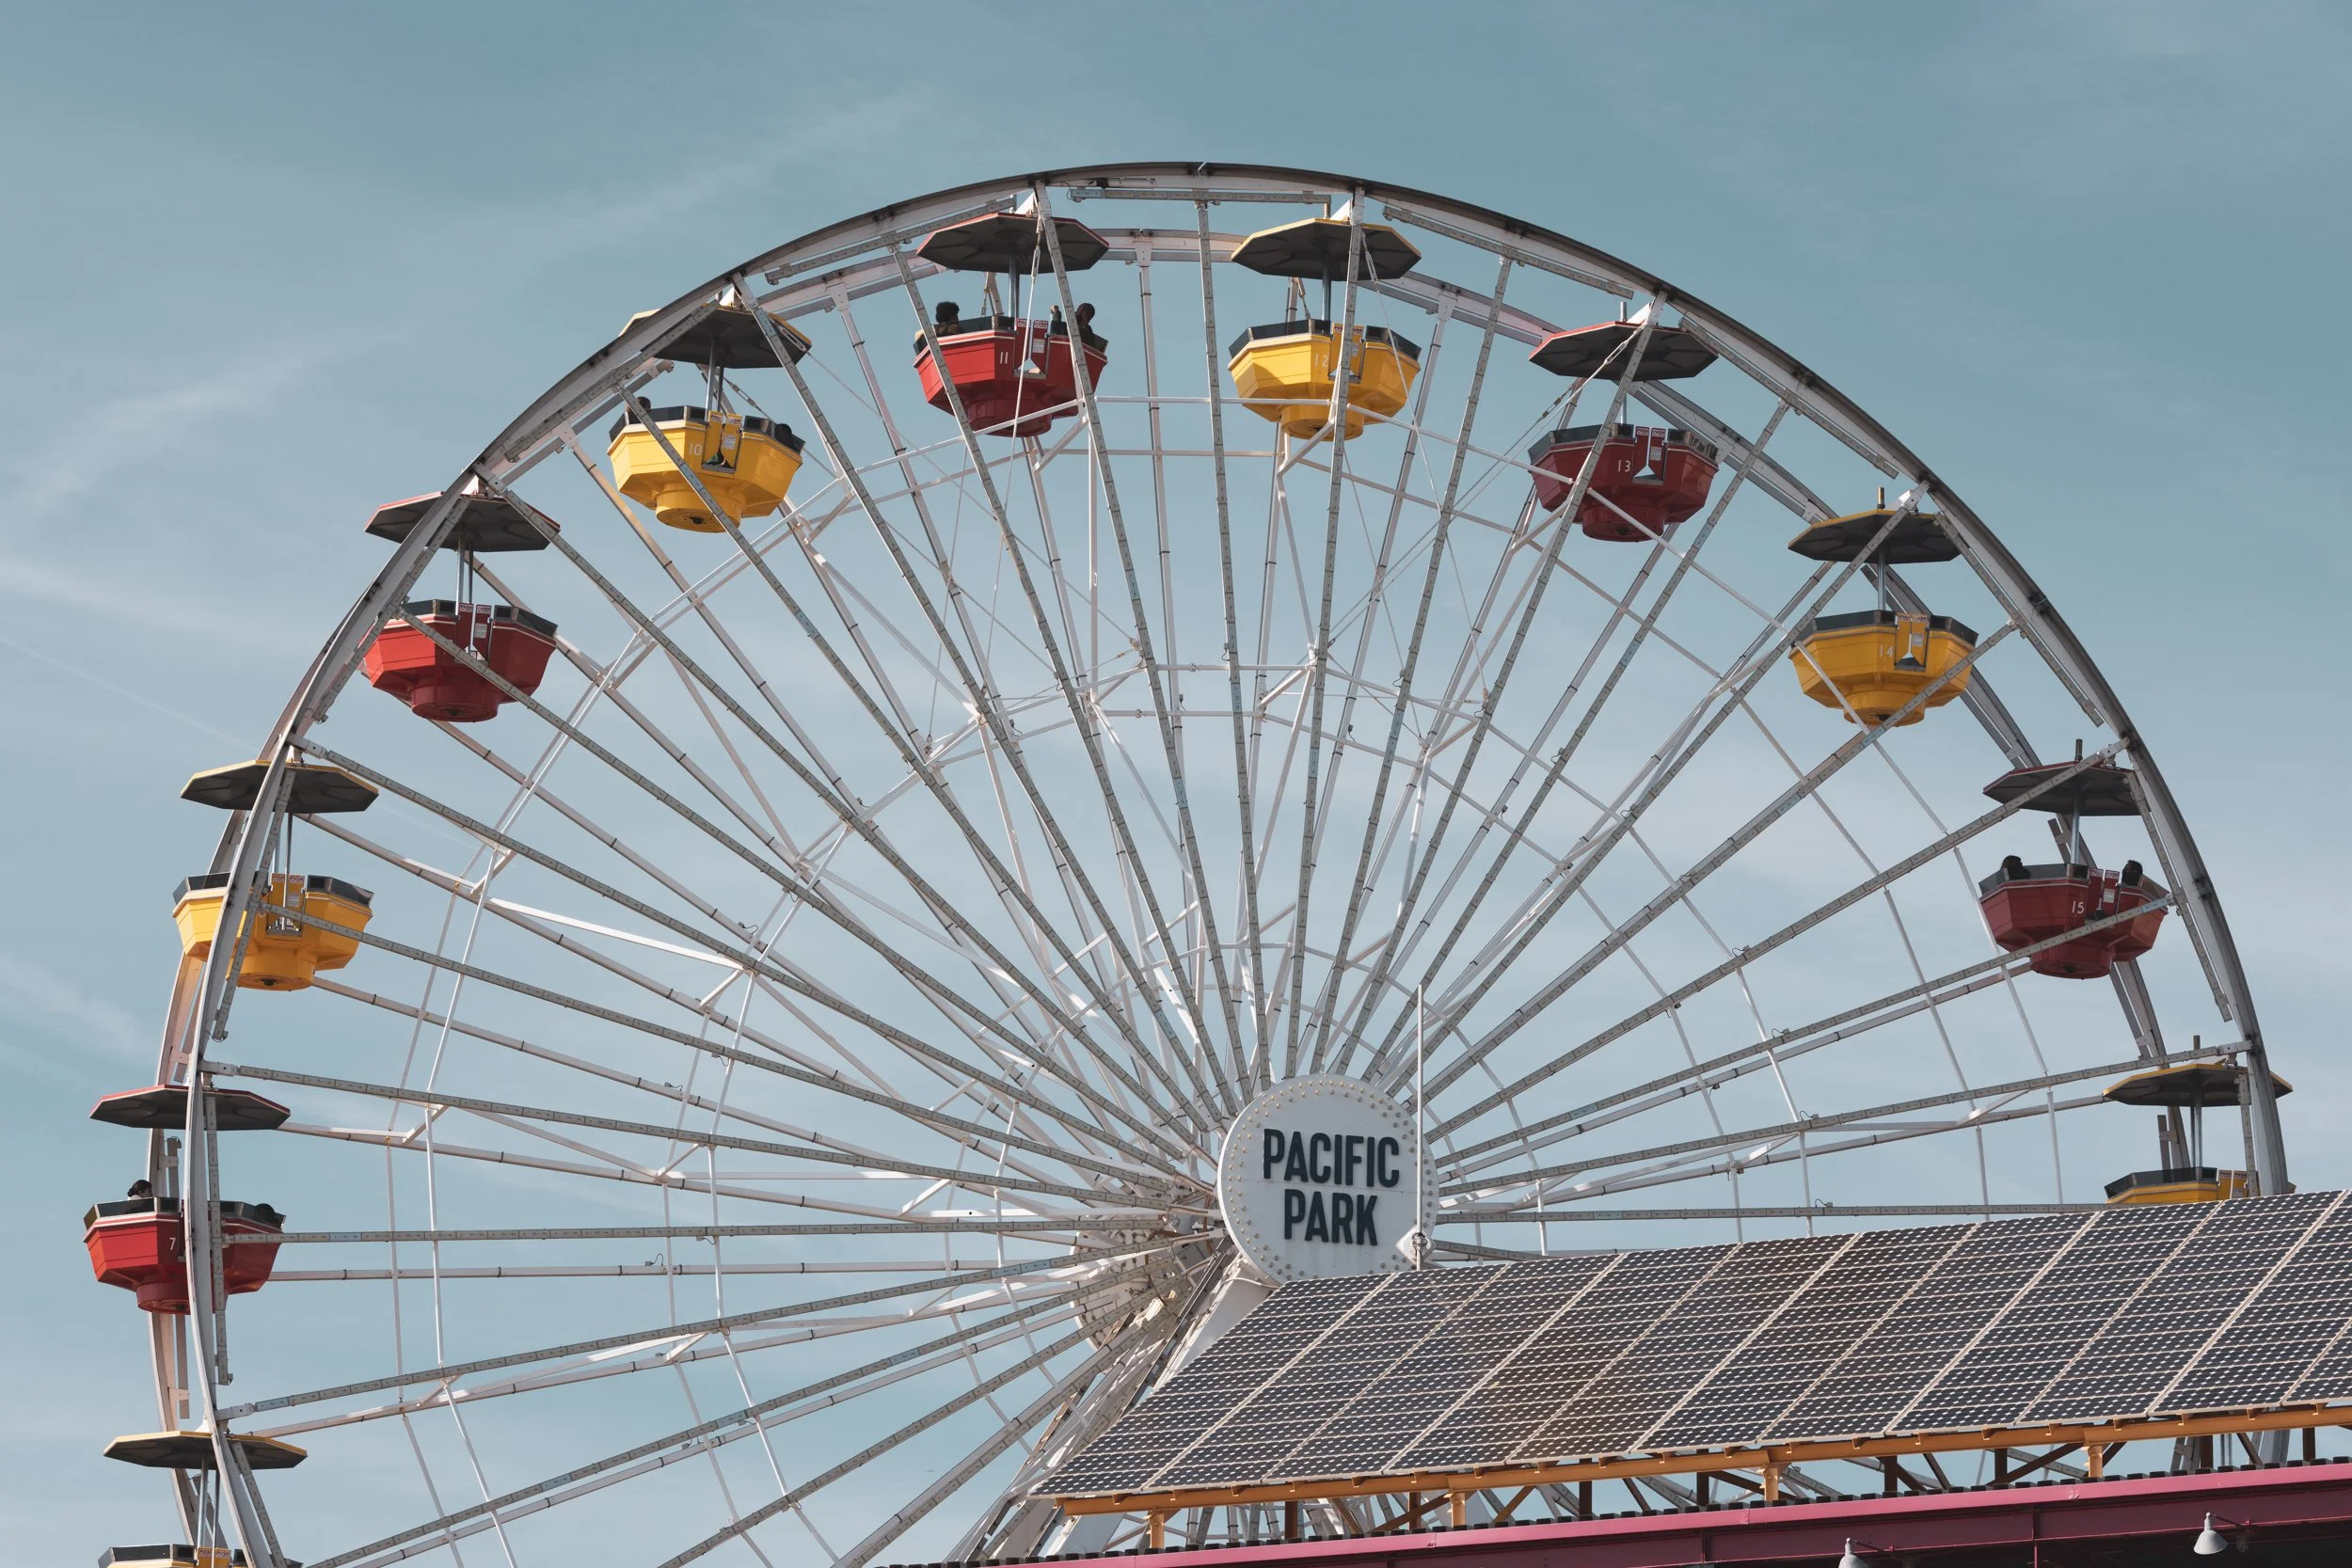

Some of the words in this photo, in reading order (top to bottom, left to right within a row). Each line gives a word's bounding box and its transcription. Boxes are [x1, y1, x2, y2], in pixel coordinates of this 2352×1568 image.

[1000, 352, 1009, 364] 11
[1314, 354, 1328, 368] 12
[689, 443, 703, 456] 10
[1618, 460, 1631, 472] 13
[1880, 645, 1894, 658] 14
[2072, 900, 2085, 914] 15
[1263, 1129, 1399, 1188] PACIFIC
[1284, 1189, 1378, 1246] PARK
[169, 1237, 177, 1251] 7
